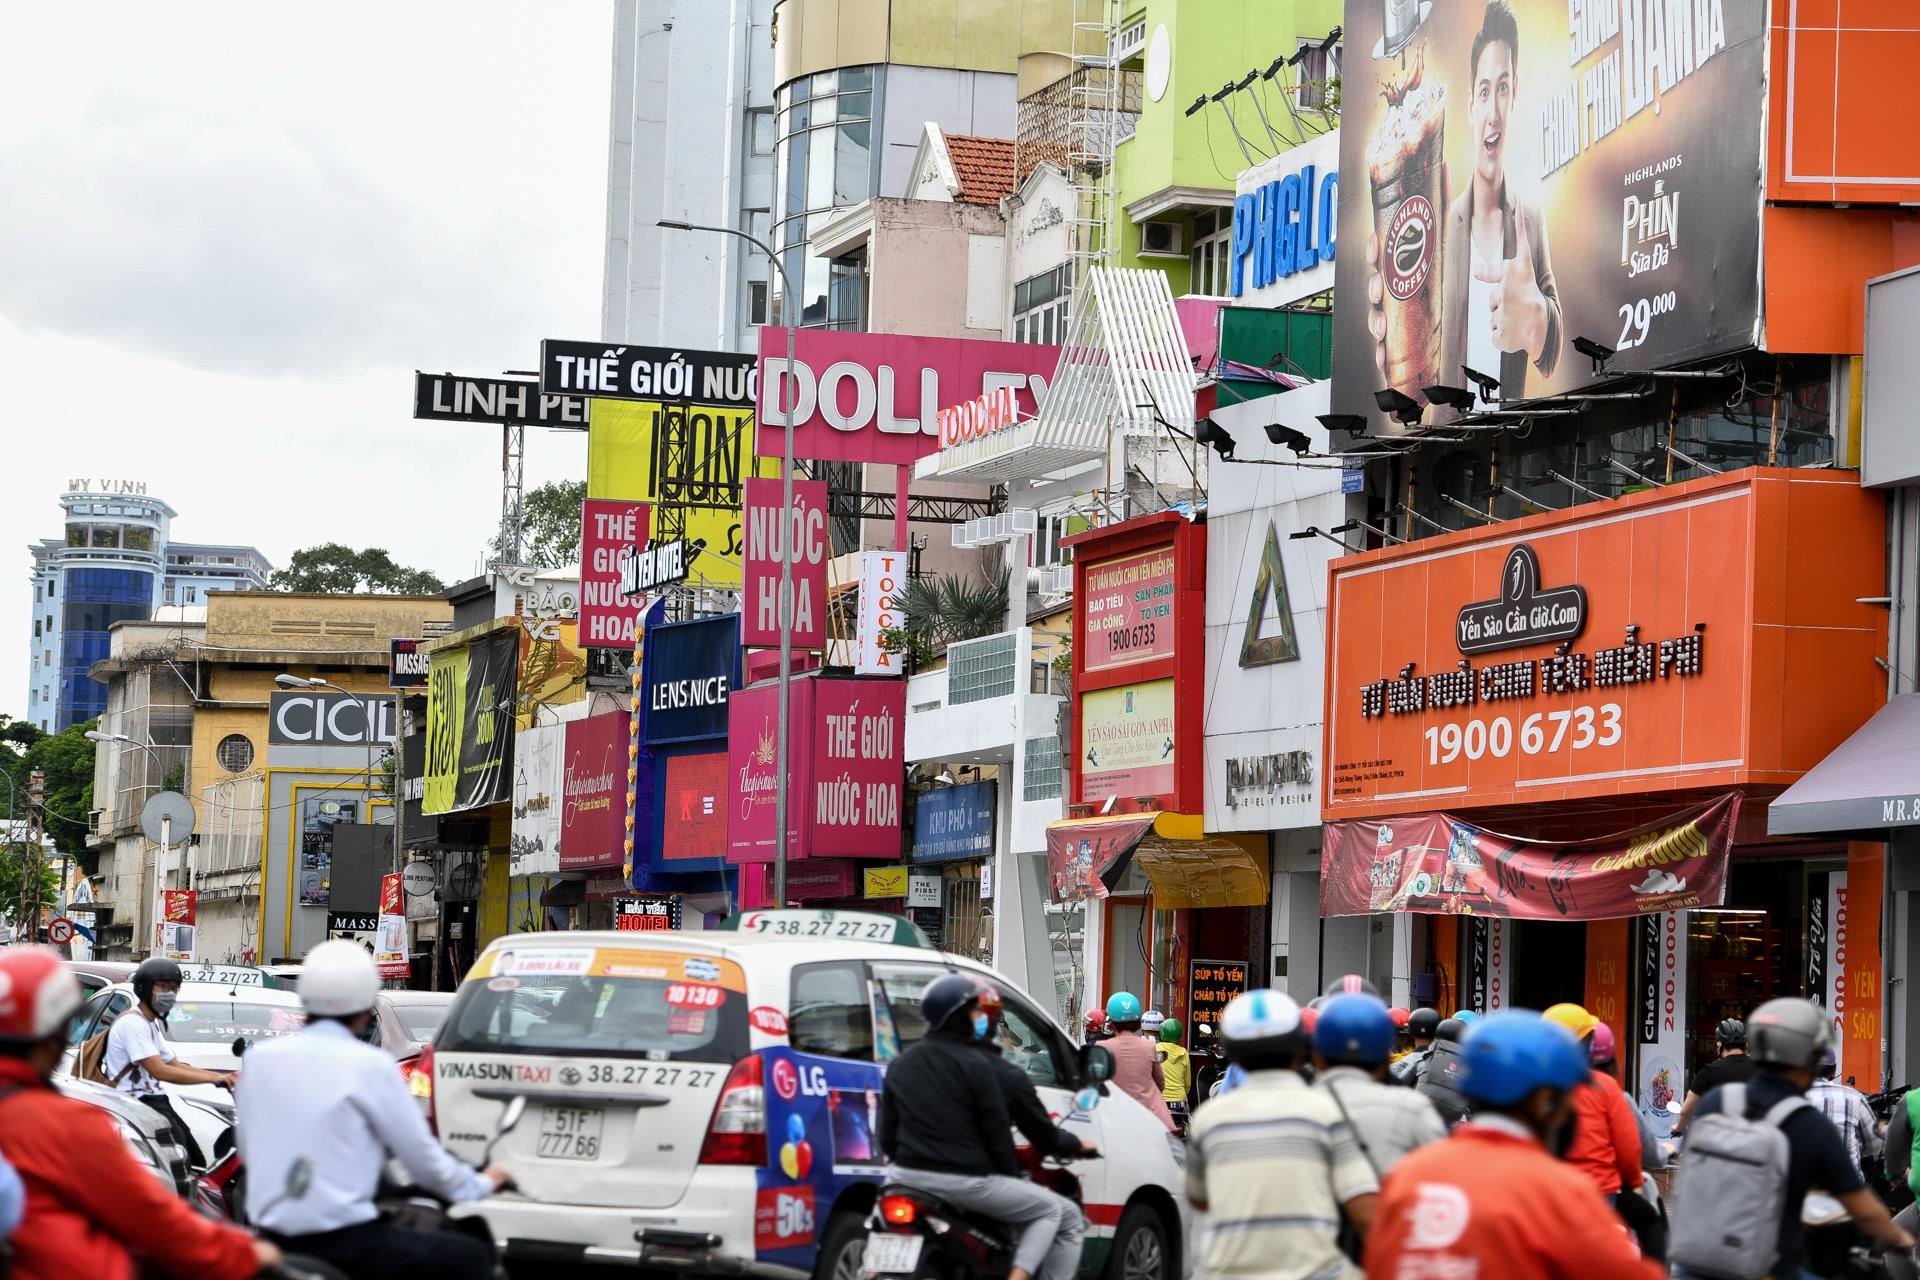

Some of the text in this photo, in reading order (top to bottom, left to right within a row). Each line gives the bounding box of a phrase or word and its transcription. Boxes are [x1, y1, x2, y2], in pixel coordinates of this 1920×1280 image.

[1624, 154, 1682, 186] HIGHLANDS
[1386, 200, 1433, 255] HIGHLANDS
[1392, 258, 1429, 293] COFFEE
[1628, 243, 1669, 279] Sữa Đá
[555, 347, 627, 392] THẾ
[630, 353, 693, 397] GIỚI
[432, 379, 589, 423] LINH PE
[936, 385, 1018, 450] TOOCHA
[646, 407, 743, 503] ICON
[100, 479, 147, 495] VINH
[594, 507, 640, 541] THẾ
[655, 540, 684, 582] HOTEL
[1123, 565, 1138, 585] CHIM
[1088, 598, 1105, 613] BAO
[1088, 613, 1124, 632] GIA CÔNG
[590, 615, 636, 642] HOA
[1108, 623, 1156, 652] 1900 6733
[1460, 614, 1481, 641] Yến
[1483, 615, 1503, 638] Sào
[1505, 605, 1527, 633] Cần
[1359, 678, 1389, 720] TƯ
[1388, 663, 1428, 716] VẤN
[1480, 660, 1537, 703] CHIM
[1659, 623, 1706, 679] PHÍ
[277, 697, 396, 742] CICIL
[827, 700, 895, 760] THẾ GIỚI
[1088, 717, 1174, 743] YẾN SÀO SÀI GÒN ANPHA
[1425, 703, 1622, 766] 1900 6733
[816, 772, 898, 827] NƯỚC HOA
[929, 811, 947, 835] KHU
[948, 798, 966, 833] PHỐ
[967, 807, 973, 829] 4
[618, 914, 672, 932] HOTEL
[645, 902, 667, 916] YẾN
[775, 919, 892, 940] 38.27 27 27
[220, 972, 238, 982] 27
[242, 973, 260, 984] 27
[1195, 966, 1243, 982] SÚP TỔ YẾN
[1853, 961, 1875, 998] YẾN
[1194, 987, 1215, 1002] CHÁO
[1216, 986, 1227, 1002] TỔ
[1644, 983, 1655, 1041] Cháo
[1852, 1007, 1875, 1040] SÀO
[587, 1065, 649, 1084] 38.27
[654, 1068, 682, 1086] 27
[687, 1070, 716, 1088] 27
[799, 1065, 829, 1096] LG
